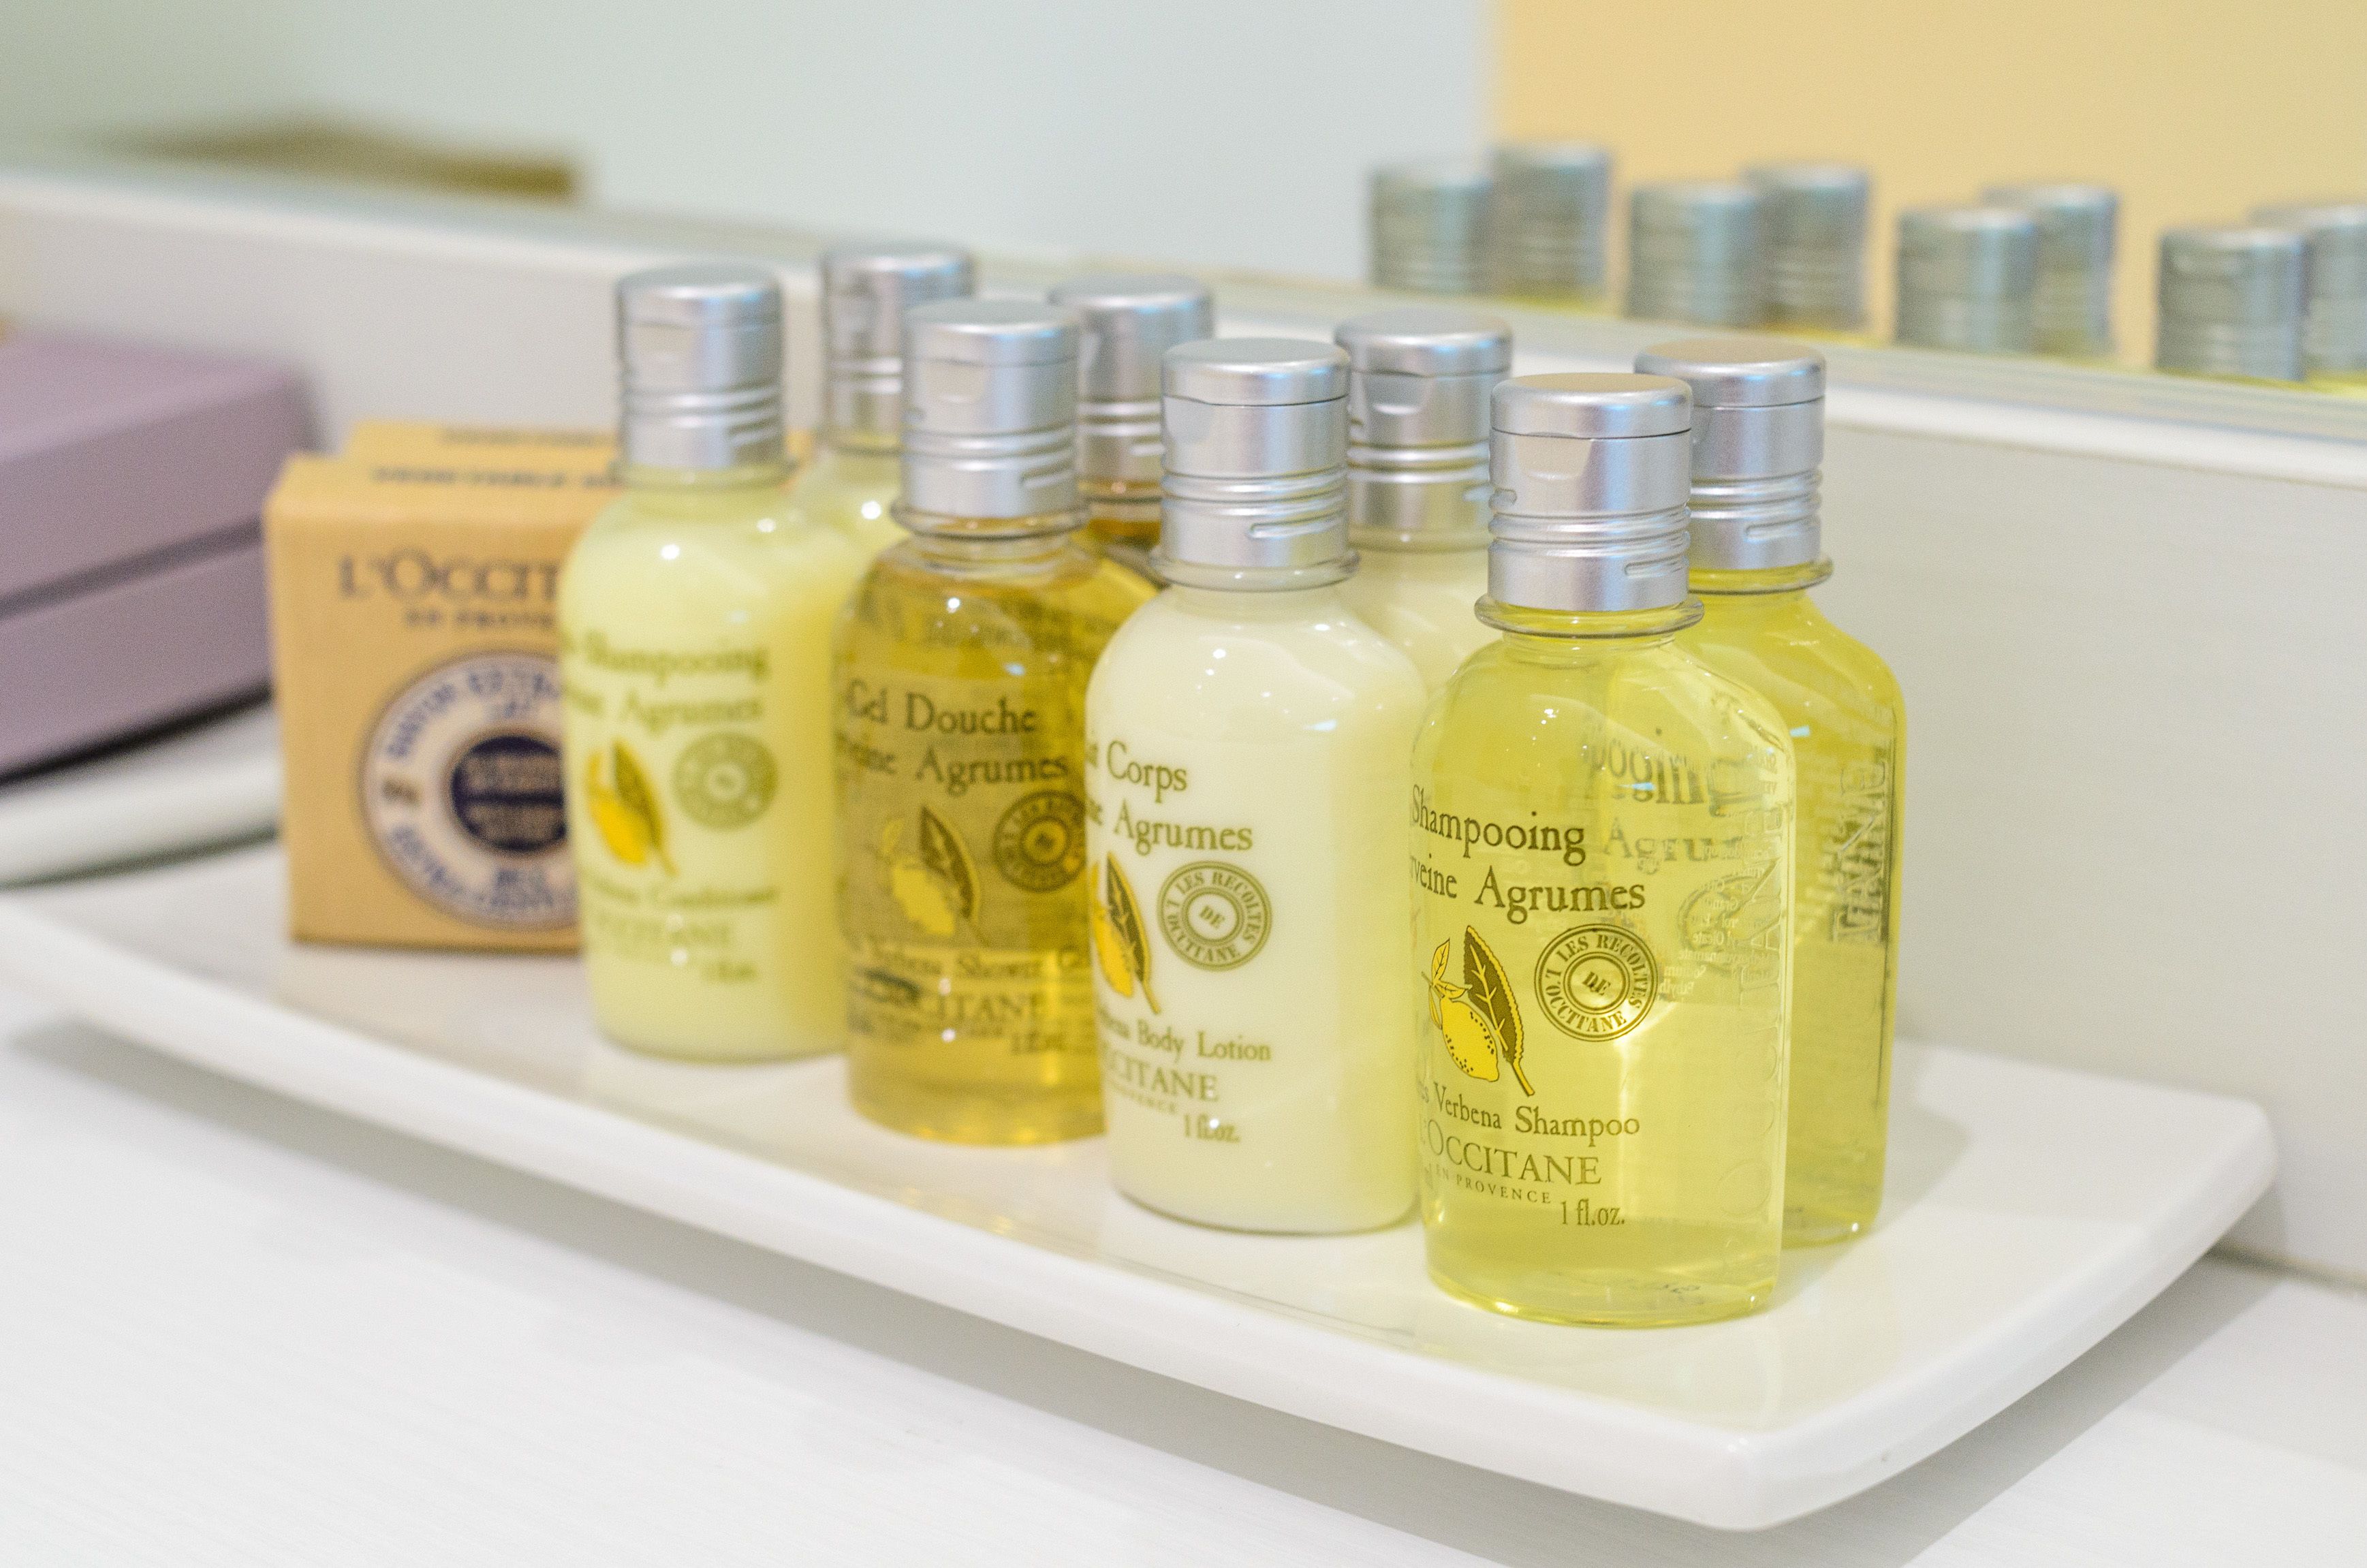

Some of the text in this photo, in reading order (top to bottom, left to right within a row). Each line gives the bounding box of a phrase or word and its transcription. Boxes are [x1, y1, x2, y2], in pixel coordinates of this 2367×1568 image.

[905, 691, 1037, 735] Douche
[915, 746, 1069, 797] Agrumes
[1107, 739, 1188, 804] Corps
[1112, 797, 1254, 857] Agrumes
[1411, 783, 1586, 867] Shampooing
[1199, 905, 1226, 931] DE
[1473, 864, 1646, 925] Agrumes
[1556, 934, 1648, 1009] LES RECOLTES
[1581, 971, 1612, 997] DE
[1137, 1018, 1185, 1064] Body
[1197, 1030, 1272, 1061] Lotion
[1433, 1081, 1503, 1129] Verbena
[1514, 1104, 1640, 1148] Shampoo
[1456, 1174, 1552, 1205] PROVENCE
[1560, 1201, 1568, 1225] 1
